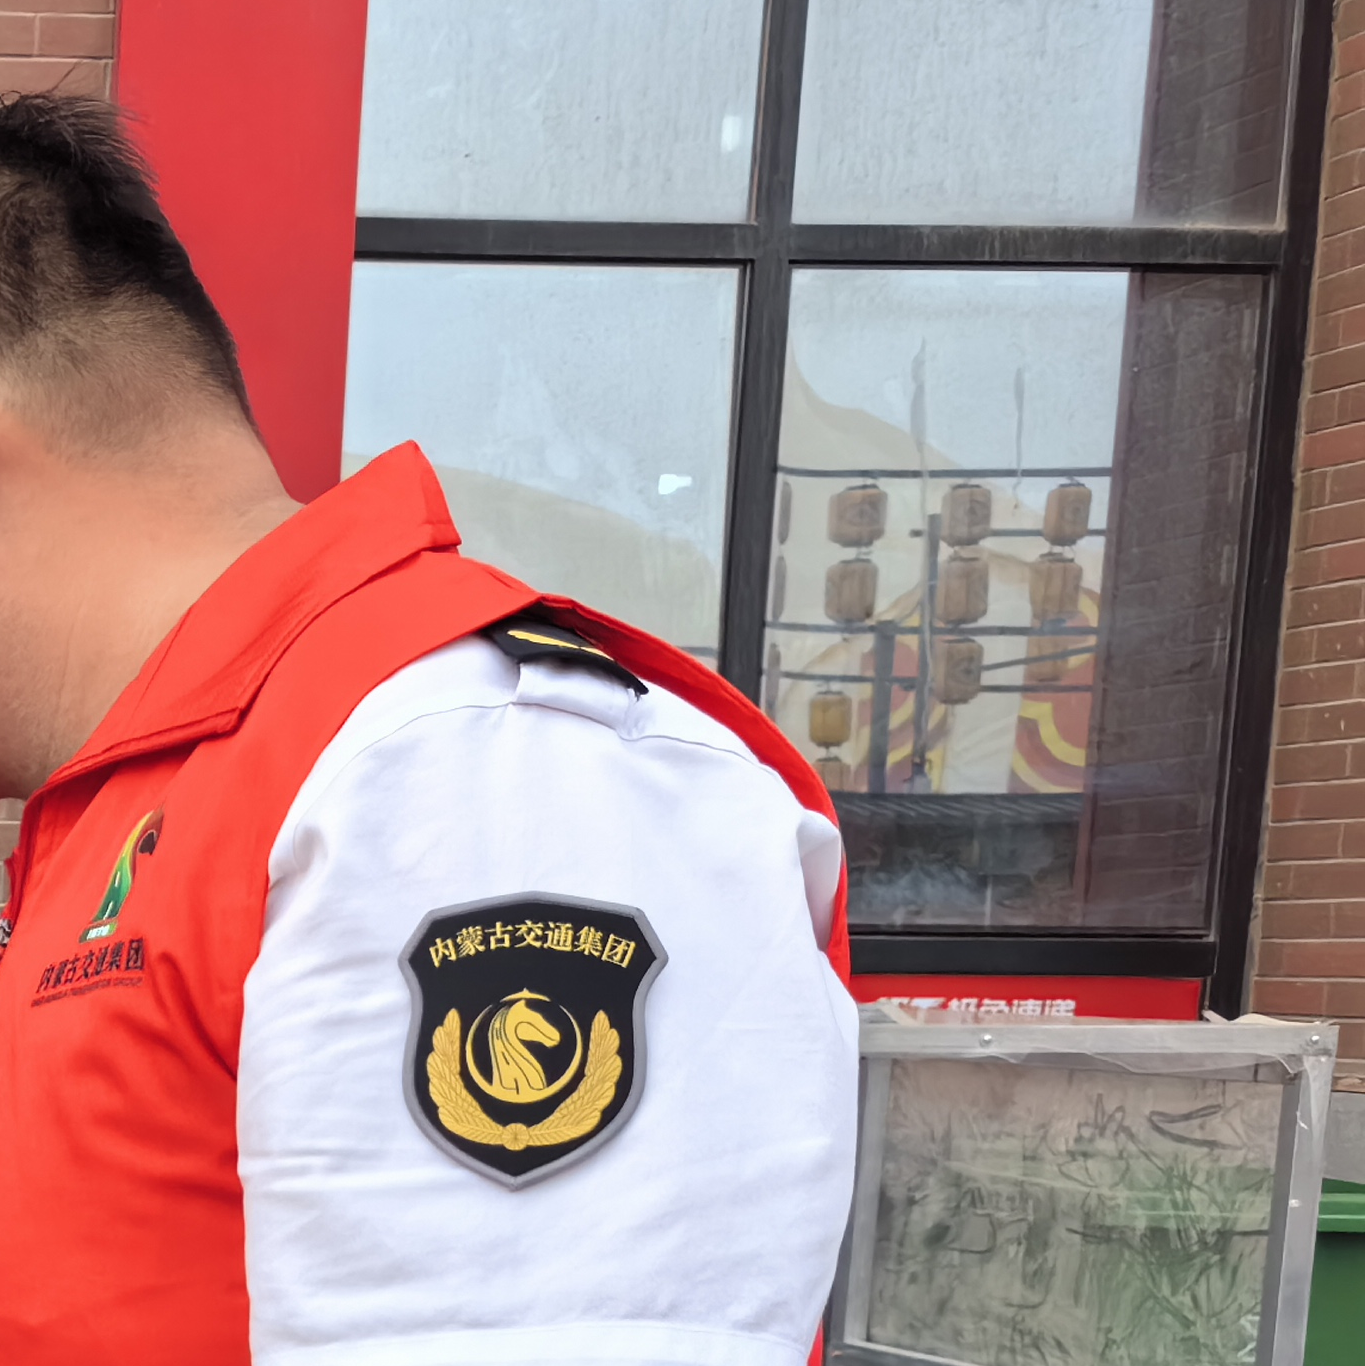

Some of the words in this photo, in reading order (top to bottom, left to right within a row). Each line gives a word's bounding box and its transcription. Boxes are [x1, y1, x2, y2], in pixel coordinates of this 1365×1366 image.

[429, 919, 636, 968] 内蒙古交通集团
